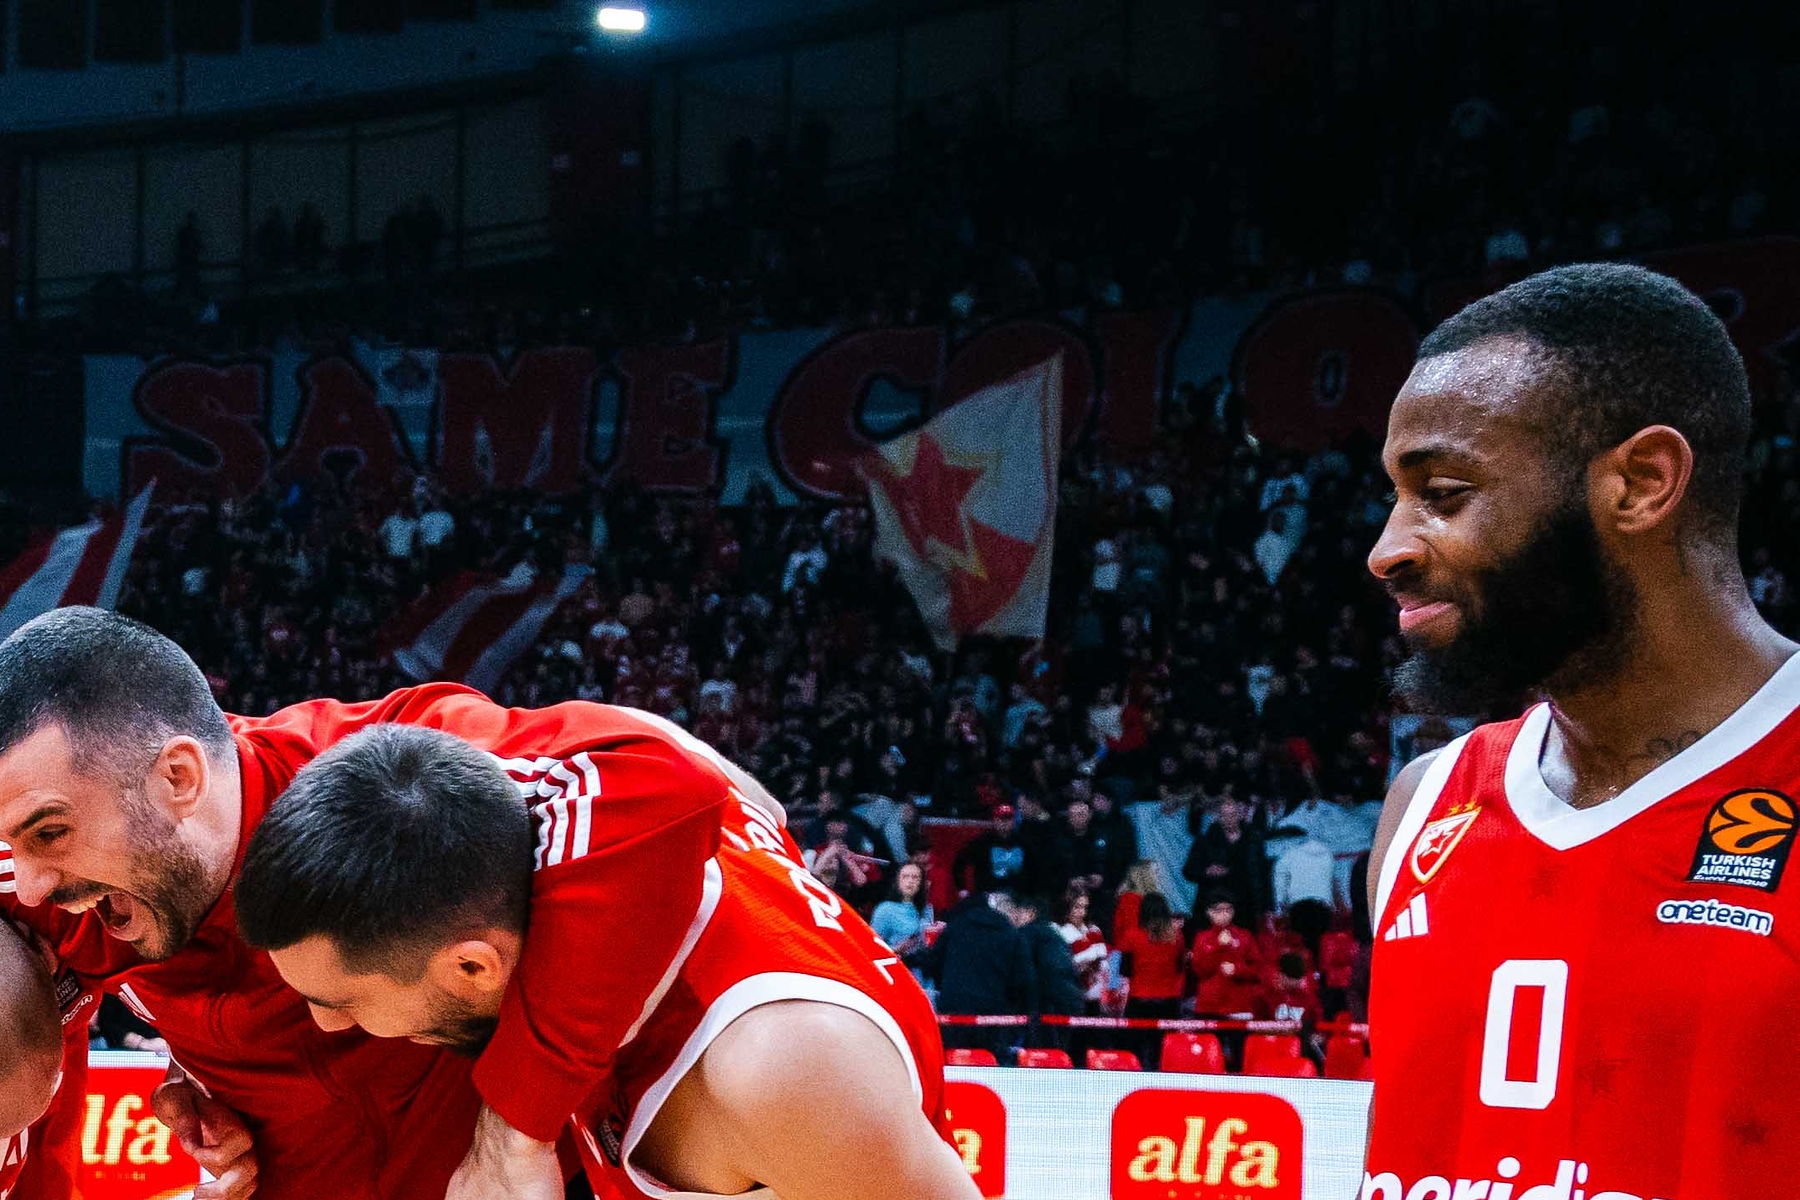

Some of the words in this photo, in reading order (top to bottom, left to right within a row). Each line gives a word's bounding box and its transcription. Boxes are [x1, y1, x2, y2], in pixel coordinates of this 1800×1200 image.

[124, 340, 731, 502] SAME
[1696, 865, 1772, 880] AIRLINES
[1701, 854, 1777, 869] TURKISH
[1659, 900, 1771, 933] oneteam
[1479, 959, 1569, 1110] 0
[81, 1094, 172, 1165] lfa
[1127, 1116, 1281, 1189] alfa
